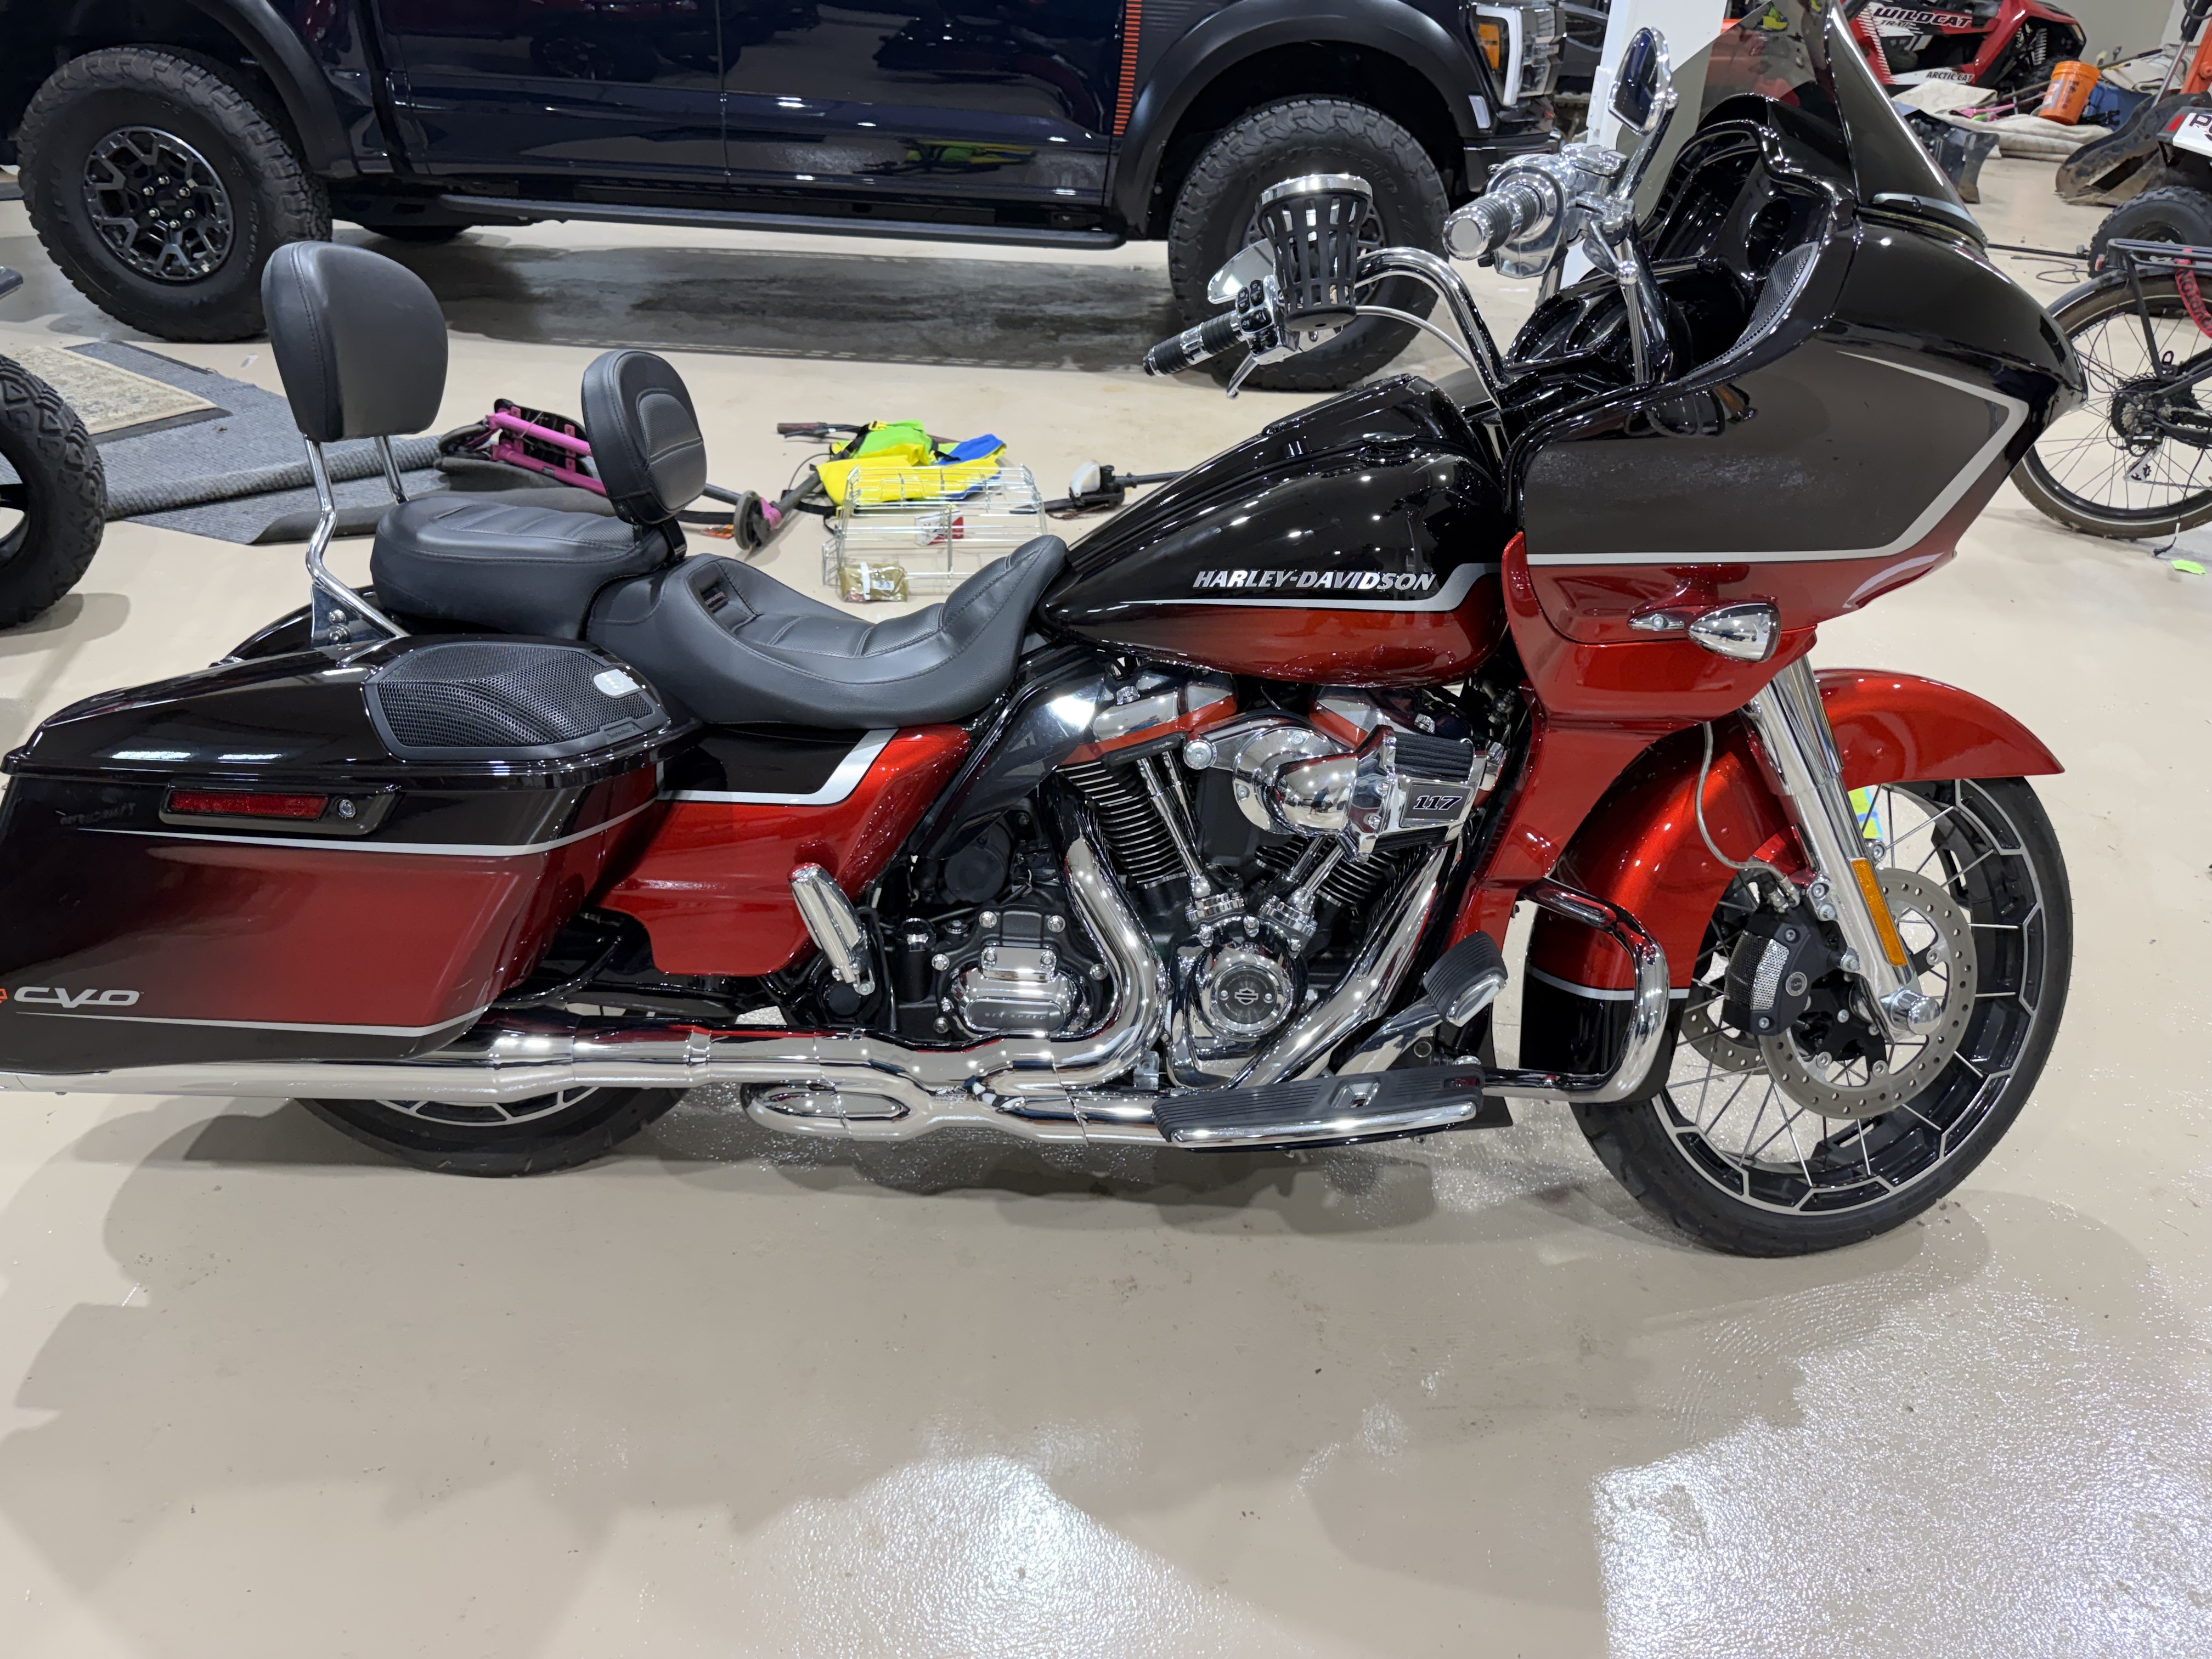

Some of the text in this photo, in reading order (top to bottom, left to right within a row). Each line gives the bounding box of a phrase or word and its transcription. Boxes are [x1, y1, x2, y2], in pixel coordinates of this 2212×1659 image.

[1873, 8, 1972, 28] WILDCAT
[1926, 71, 1974, 82] ARCTIC CAT
[1193, 569, 1436, 591] HARLEY-DAVIDSON
[1413, 795, 1463, 810] 117
[14, 986, 139, 1008] CVO
